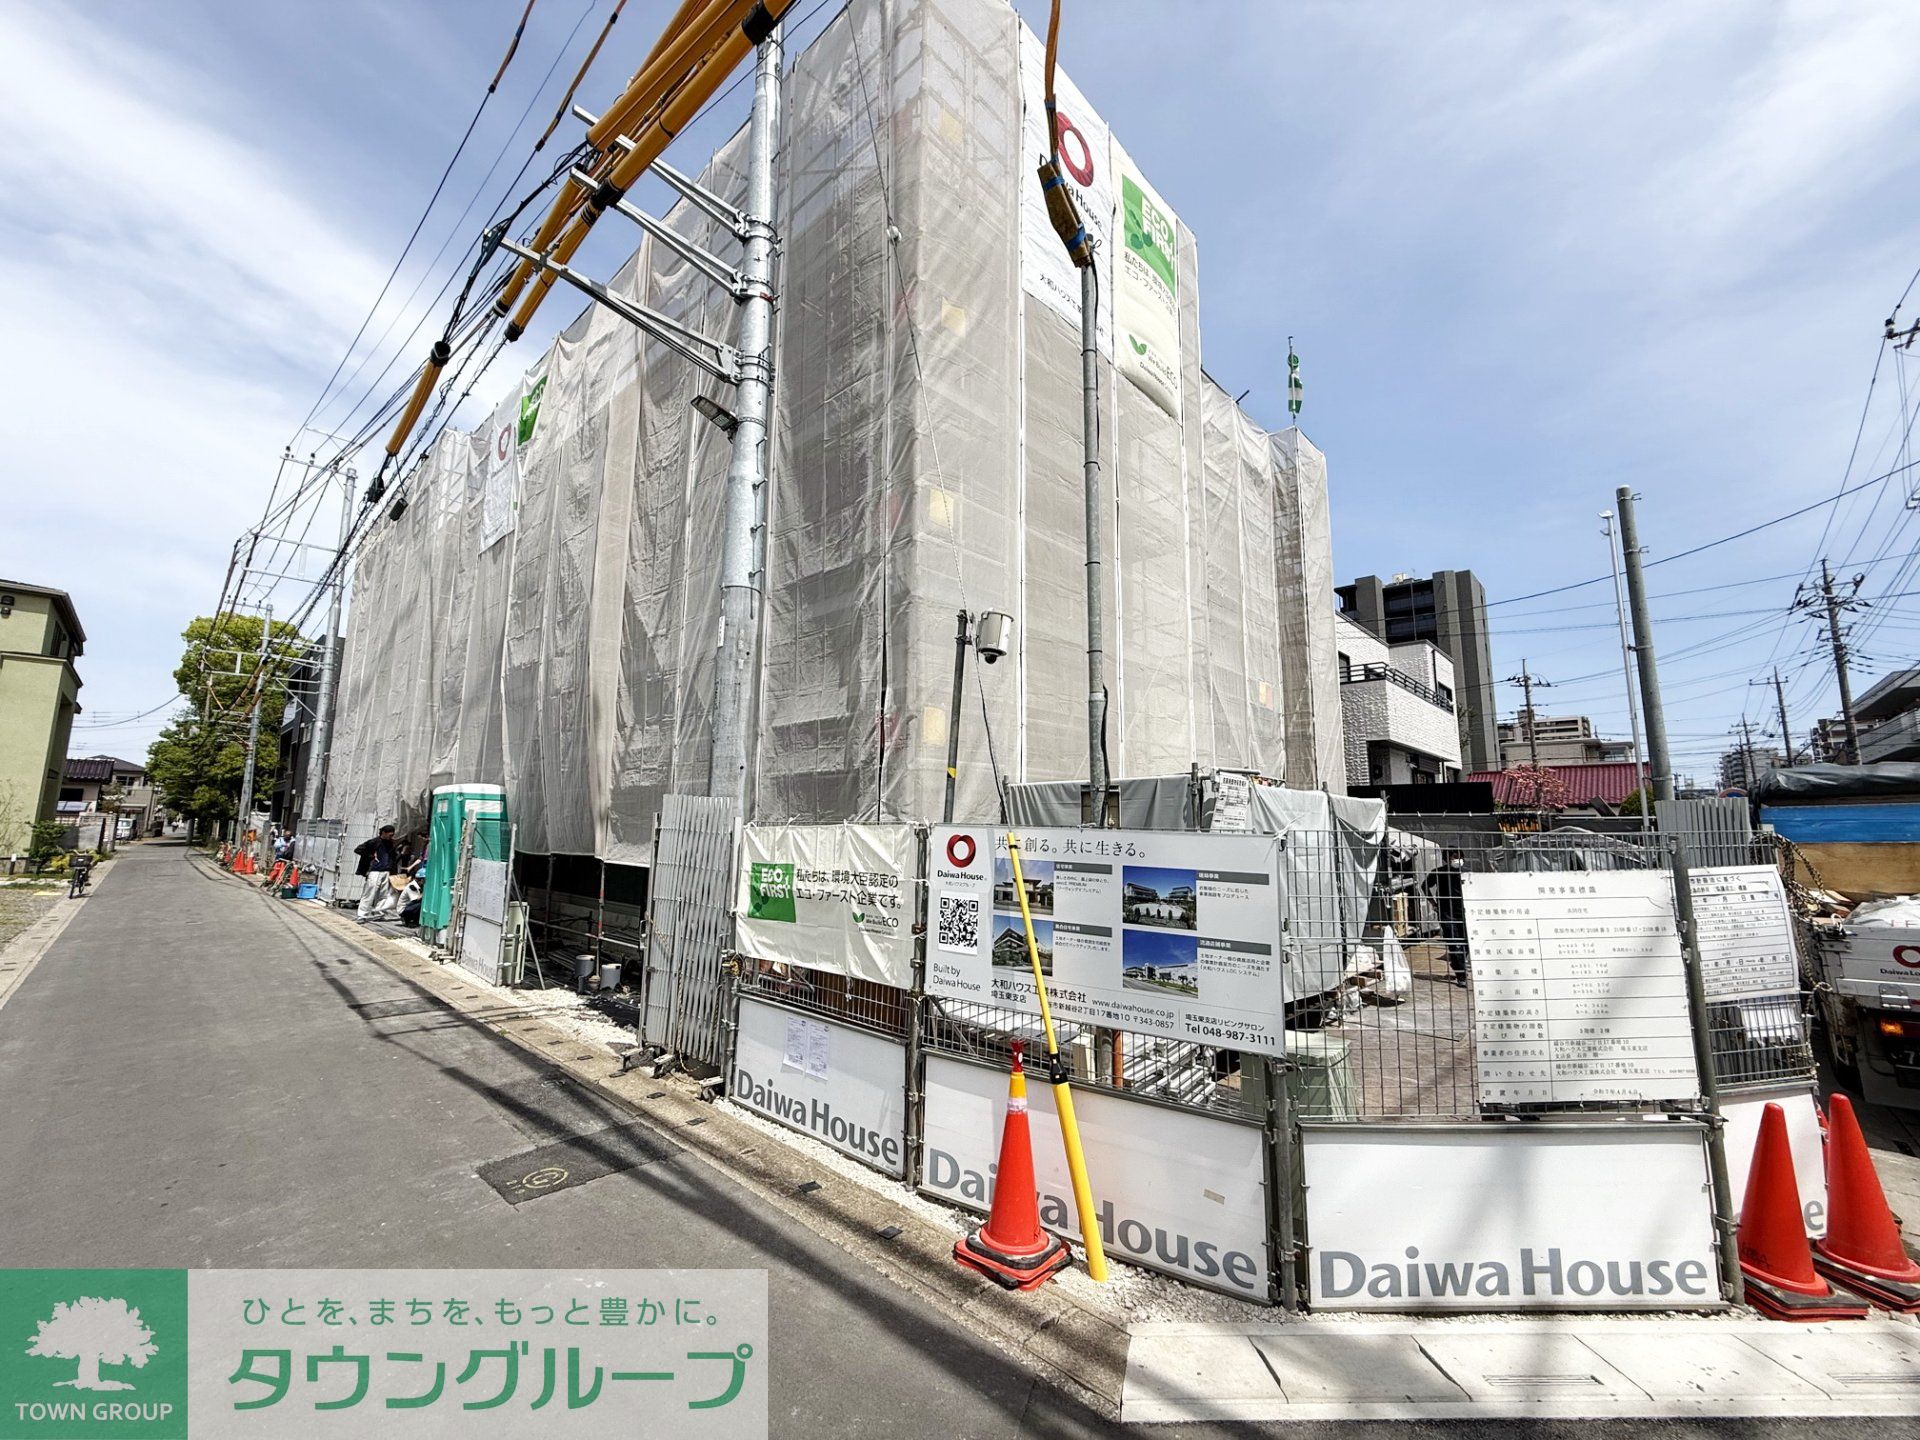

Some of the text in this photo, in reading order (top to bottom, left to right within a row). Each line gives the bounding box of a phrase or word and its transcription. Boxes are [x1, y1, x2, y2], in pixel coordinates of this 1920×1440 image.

[761, 868, 783, 883] ECO
[796, 869, 899, 889] 私たちは、環境大臣認定の
[937, 870, 984, 880] Daiwa House
[760, 881, 791, 899] FIRST
[796, 888, 902, 909] エコ・ファースト企業です。
[882, 917, 899, 928] ECO
[933, 963, 961, 977] Built by
[932, 975, 981, 992] Daiwa House
[990, 990, 1027, 1004] 埼玉東支店
[1091, 999, 1175, 1020] www.daiwahouse.co.jp
[1185, 1013, 1265, 1032] 埼玉東支店リビングサロン
[1185, 1023, 1275, 1046] Tel 048-987-3111
[737, 1069, 899, 1166] Daiwa House
[929, 1148, 1068, 1230] Daia
[1320, 1246, 1509, 1299] Daiwa
[1520, 1247, 1709, 1297] House
